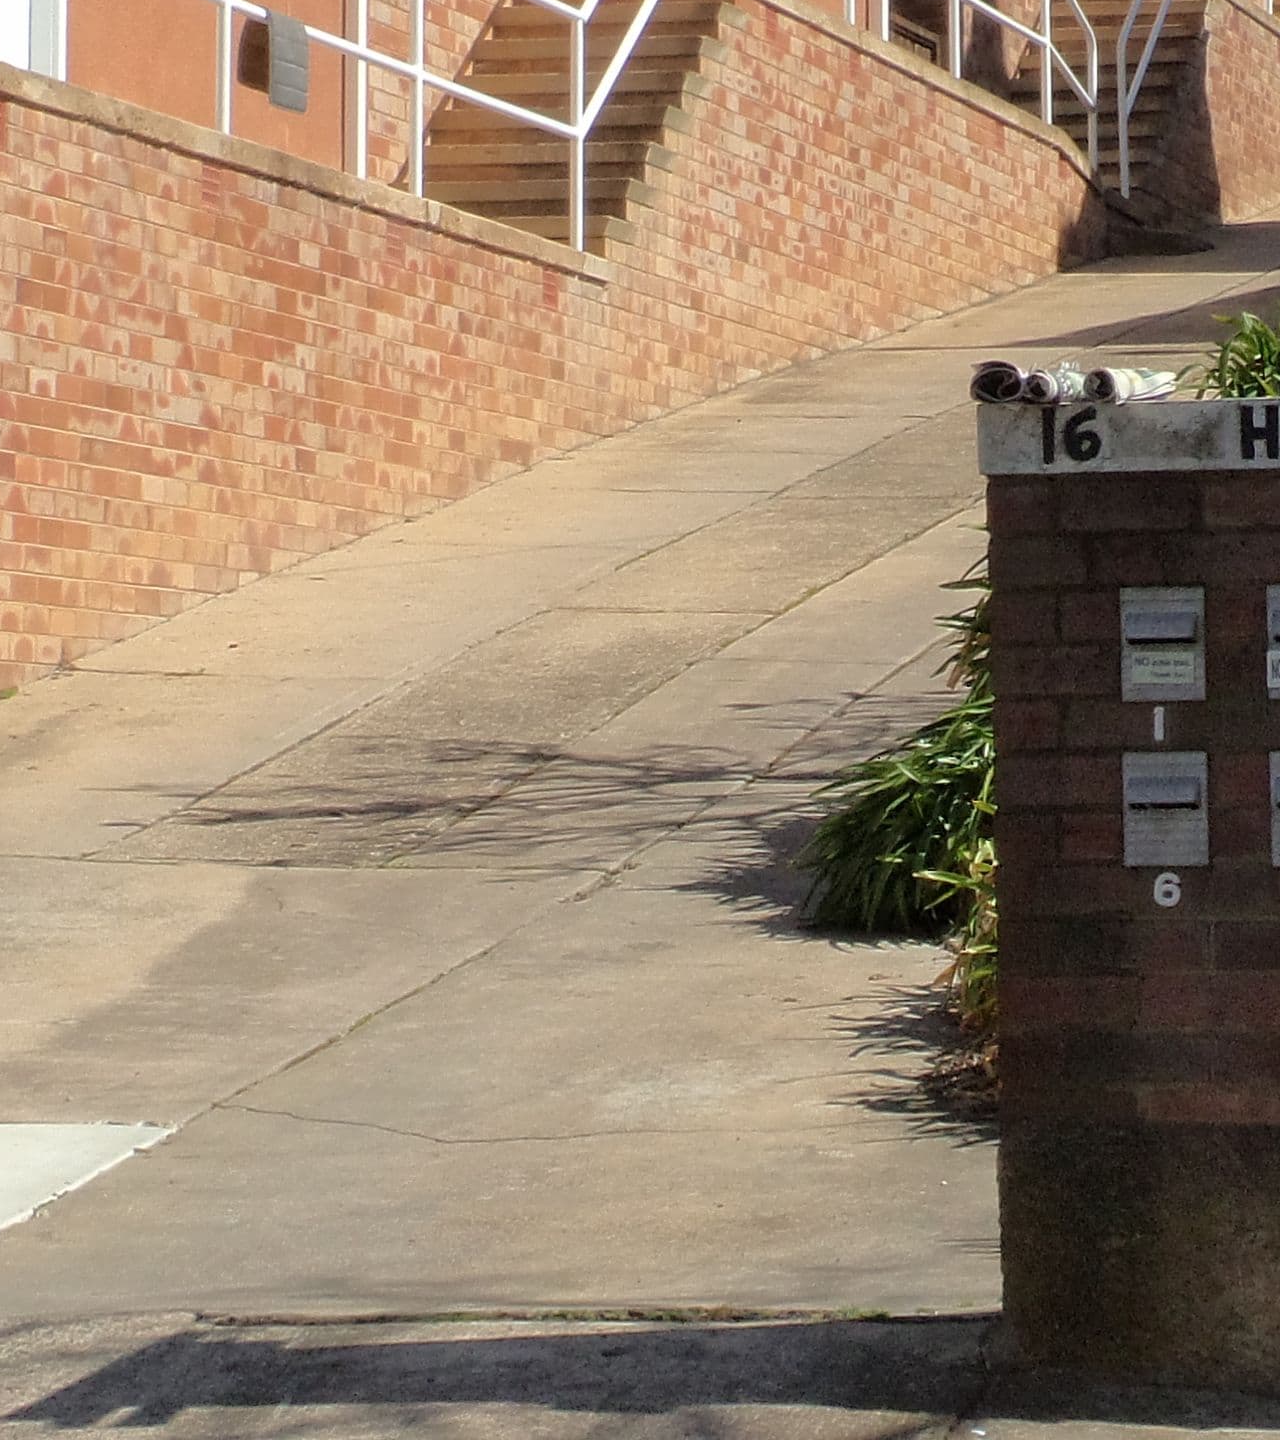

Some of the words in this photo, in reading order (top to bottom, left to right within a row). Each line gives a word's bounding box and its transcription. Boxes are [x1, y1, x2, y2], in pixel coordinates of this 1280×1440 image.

[1041, 404, 1102, 465] 16
[1152, 705, 1165, 742] 1
[1153, 871, 1181, 907] 6
